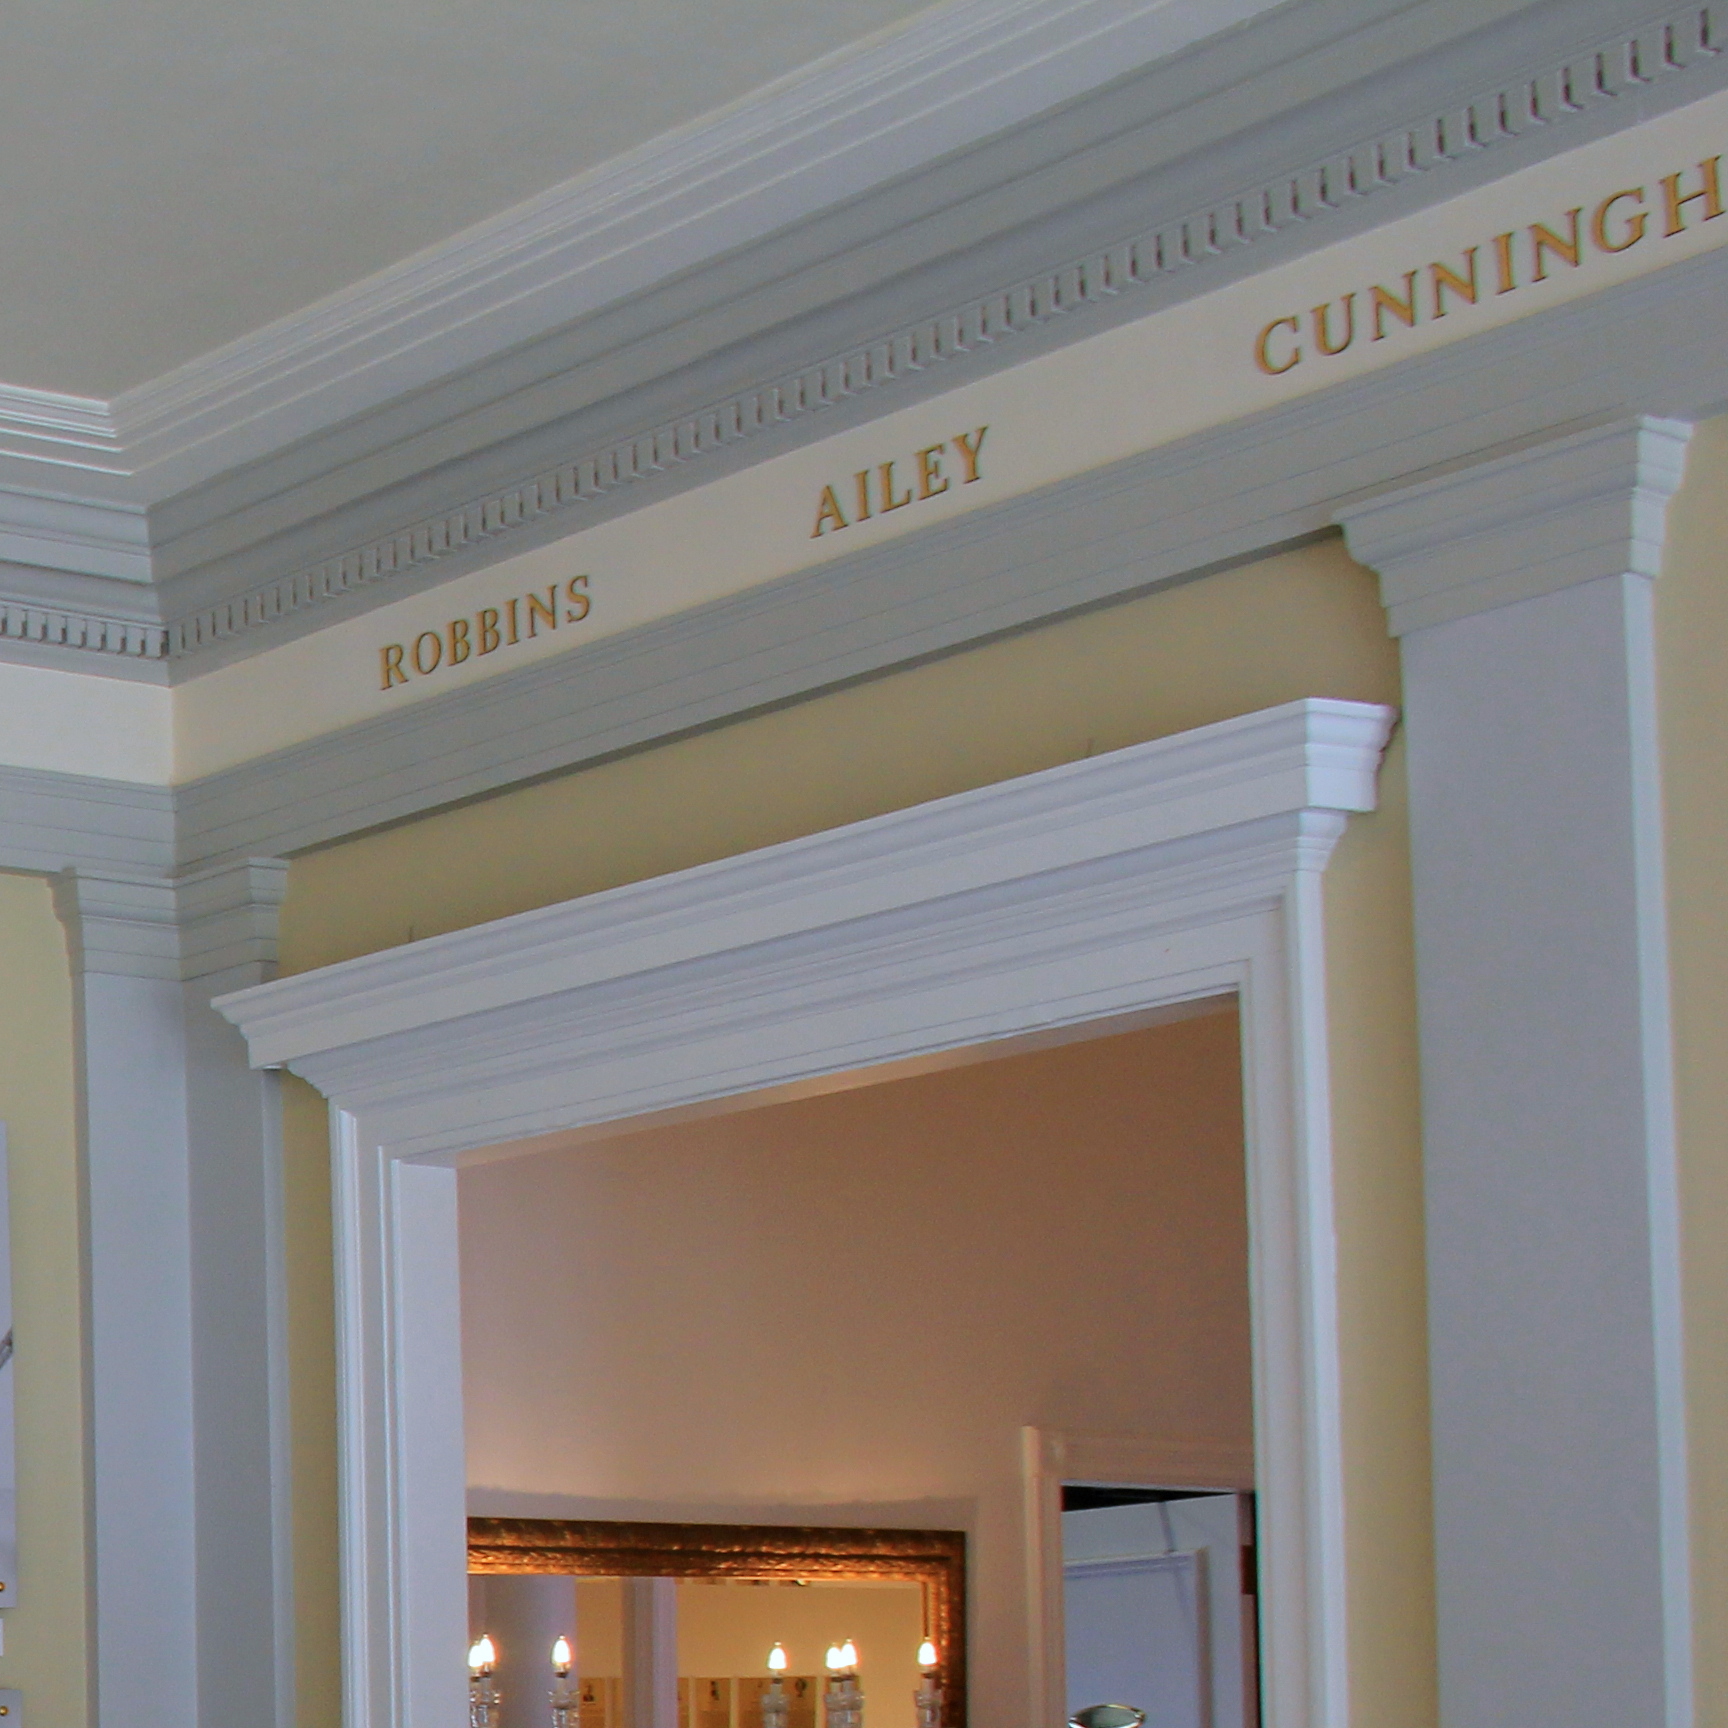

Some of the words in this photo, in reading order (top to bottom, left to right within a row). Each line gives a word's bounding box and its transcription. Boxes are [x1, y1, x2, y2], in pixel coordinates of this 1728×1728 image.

[1254, 155, 1727, 375] CUNNINGH
[811, 426, 989, 538] AILEY
[379, 574, 594, 690] ROBBINS
